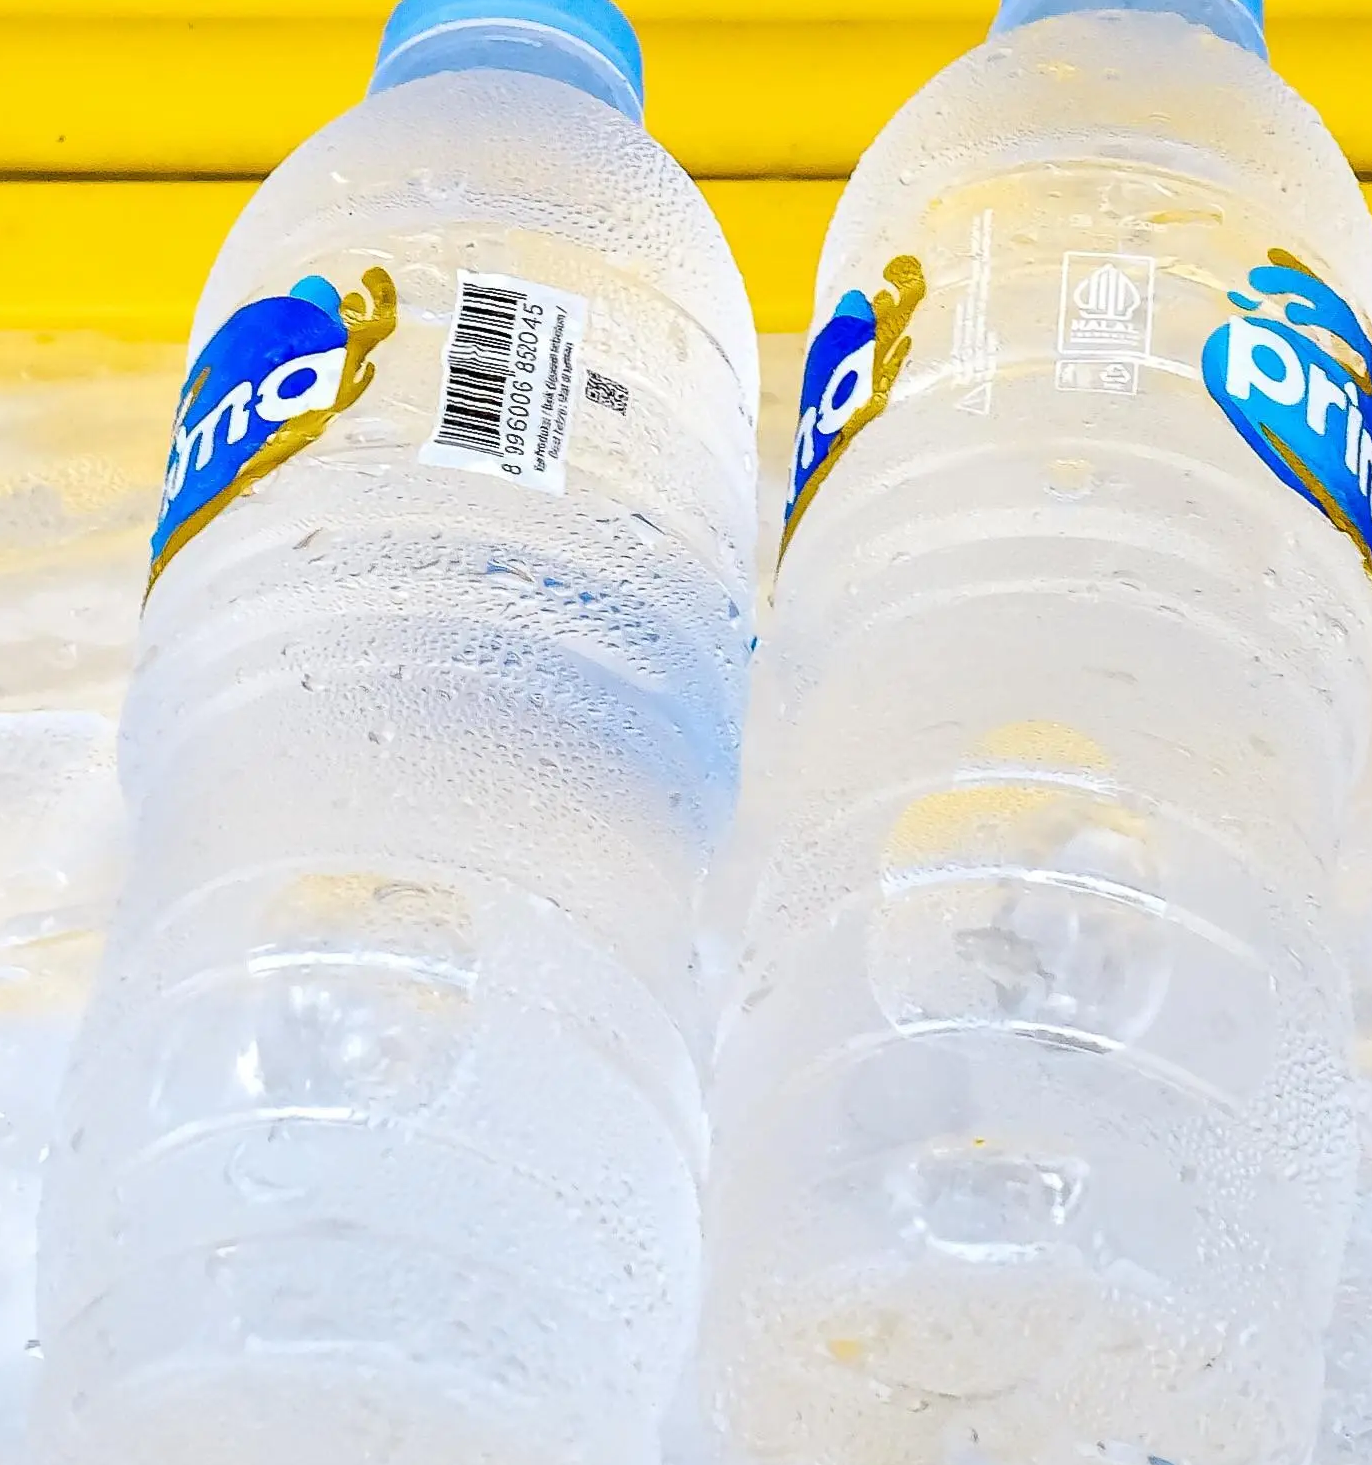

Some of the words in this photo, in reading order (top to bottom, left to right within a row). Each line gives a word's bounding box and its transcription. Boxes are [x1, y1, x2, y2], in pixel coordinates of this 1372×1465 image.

[514, 303, 544, 374] 852045
[504, 380, 534, 456] 996006
[501, 463, 522, 476] 8
